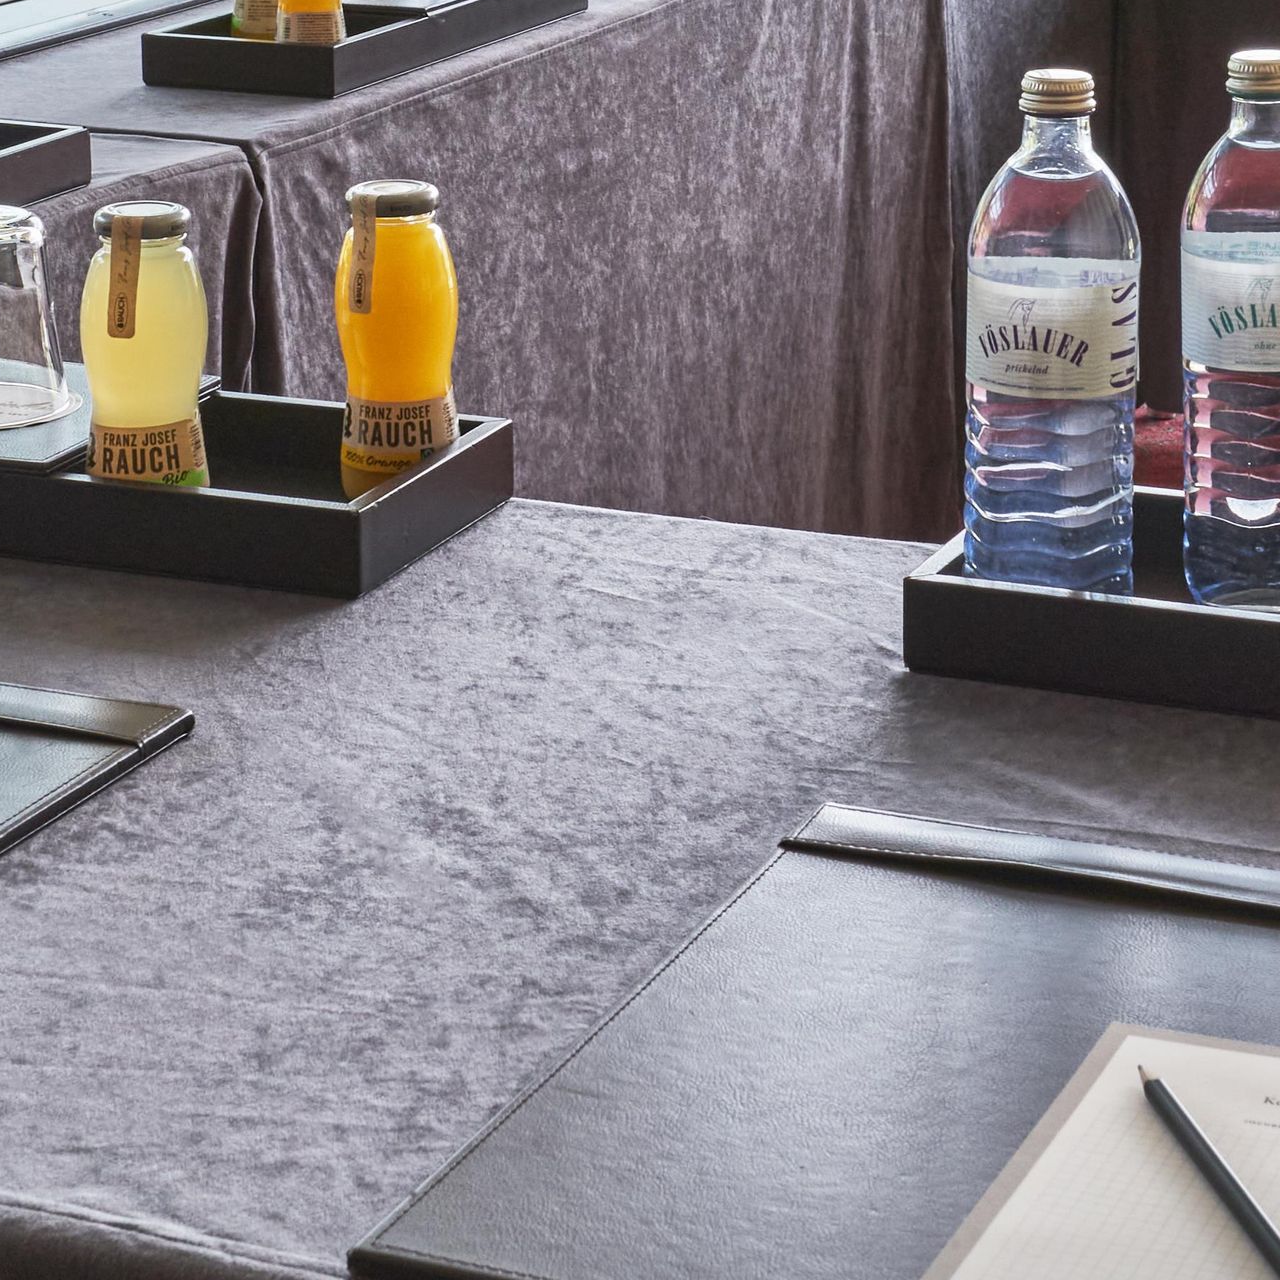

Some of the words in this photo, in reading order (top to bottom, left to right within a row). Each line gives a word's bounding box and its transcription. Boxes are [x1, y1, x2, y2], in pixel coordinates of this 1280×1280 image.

[978, 324, 1089, 368] VÖSLAUER
[1004, 363, 1050, 375] prickelnd
[360, 404, 392, 421] FRANZ
[396, 404, 431, 420] JOSEF
[103, 432, 138, 448] FRANZ
[142, 428, 177, 447] JOSEF
[358, 419, 433, 448] RAUCH
[102, 443, 181, 475] RAUCH
[162, 470, 190, 485] Bio
